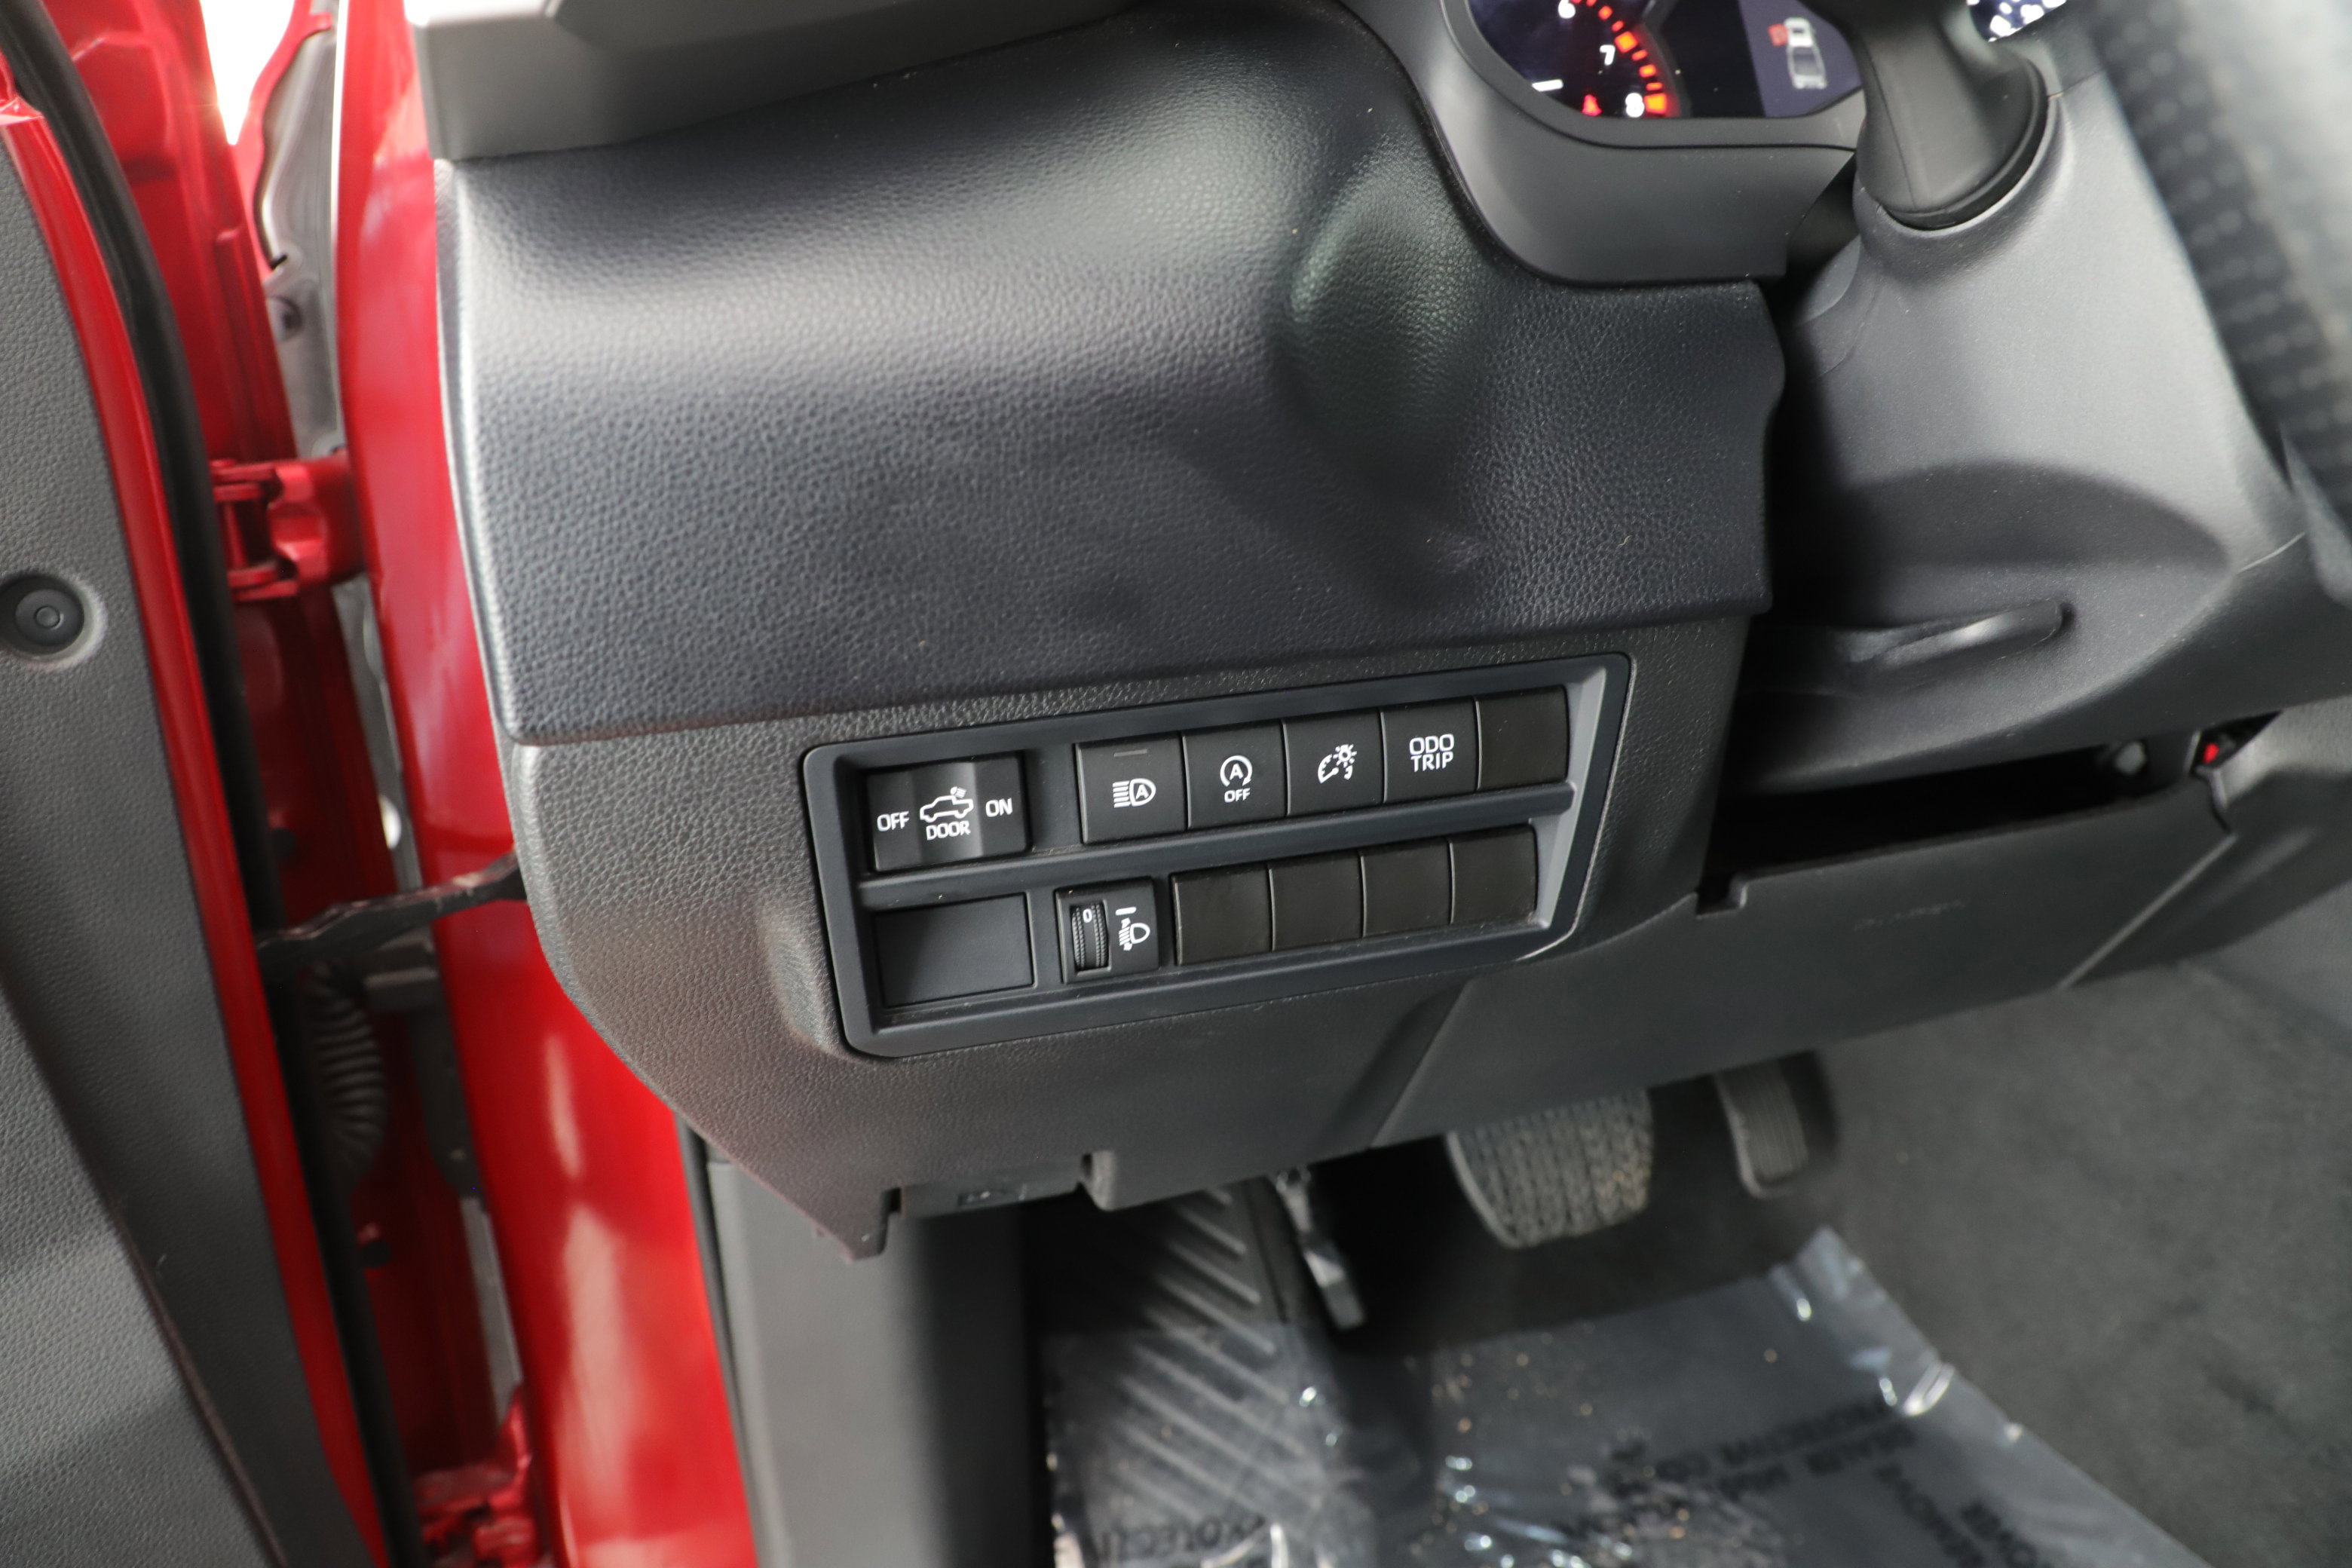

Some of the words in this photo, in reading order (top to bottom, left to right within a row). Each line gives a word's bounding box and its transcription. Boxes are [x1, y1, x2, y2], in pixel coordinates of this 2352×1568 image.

[1557, 0, 1576, 19] 6
[1599, 44, 1615, 66] 7
[1625, 92, 1645, 118] 8
[1409, 733, 1455, 755] ODO
[1410, 751, 1454, 772] TRIP
[1223, 788, 1251, 803] OFF
[985, 798, 1013, 817] ON
[877, 810, 910, 831] OFF
[926, 820, 972, 841] DOOR
[1083, 908, 1092, 923] 0
